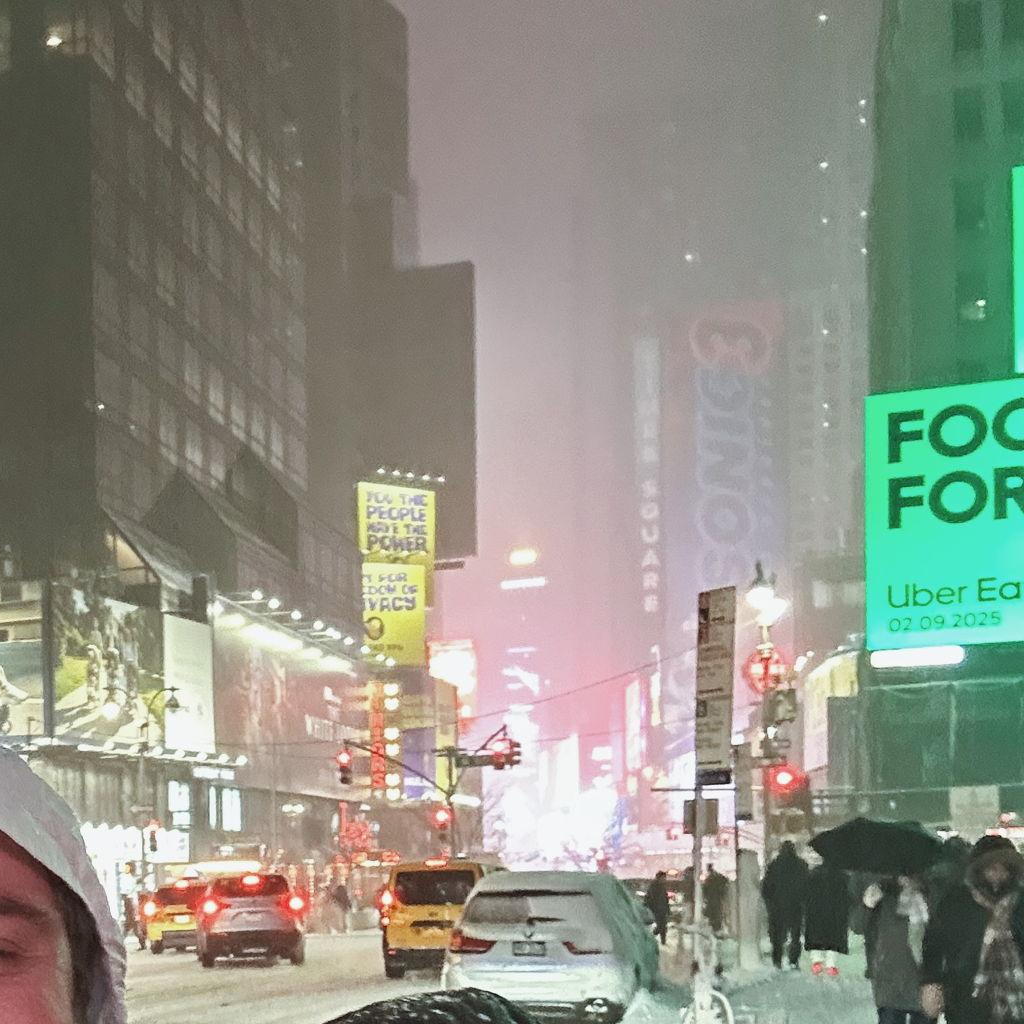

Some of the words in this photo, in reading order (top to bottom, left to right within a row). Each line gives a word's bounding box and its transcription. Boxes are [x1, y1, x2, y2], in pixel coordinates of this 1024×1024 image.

[400, 493, 429, 507] THE
[887, 466, 1024, 530] FOR
[366, 505, 427, 522] PEOPLE
[403, 523, 429, 535] THE
[367, 534, 429, 554] POWER
[887, 583, 968, 609] Uber
